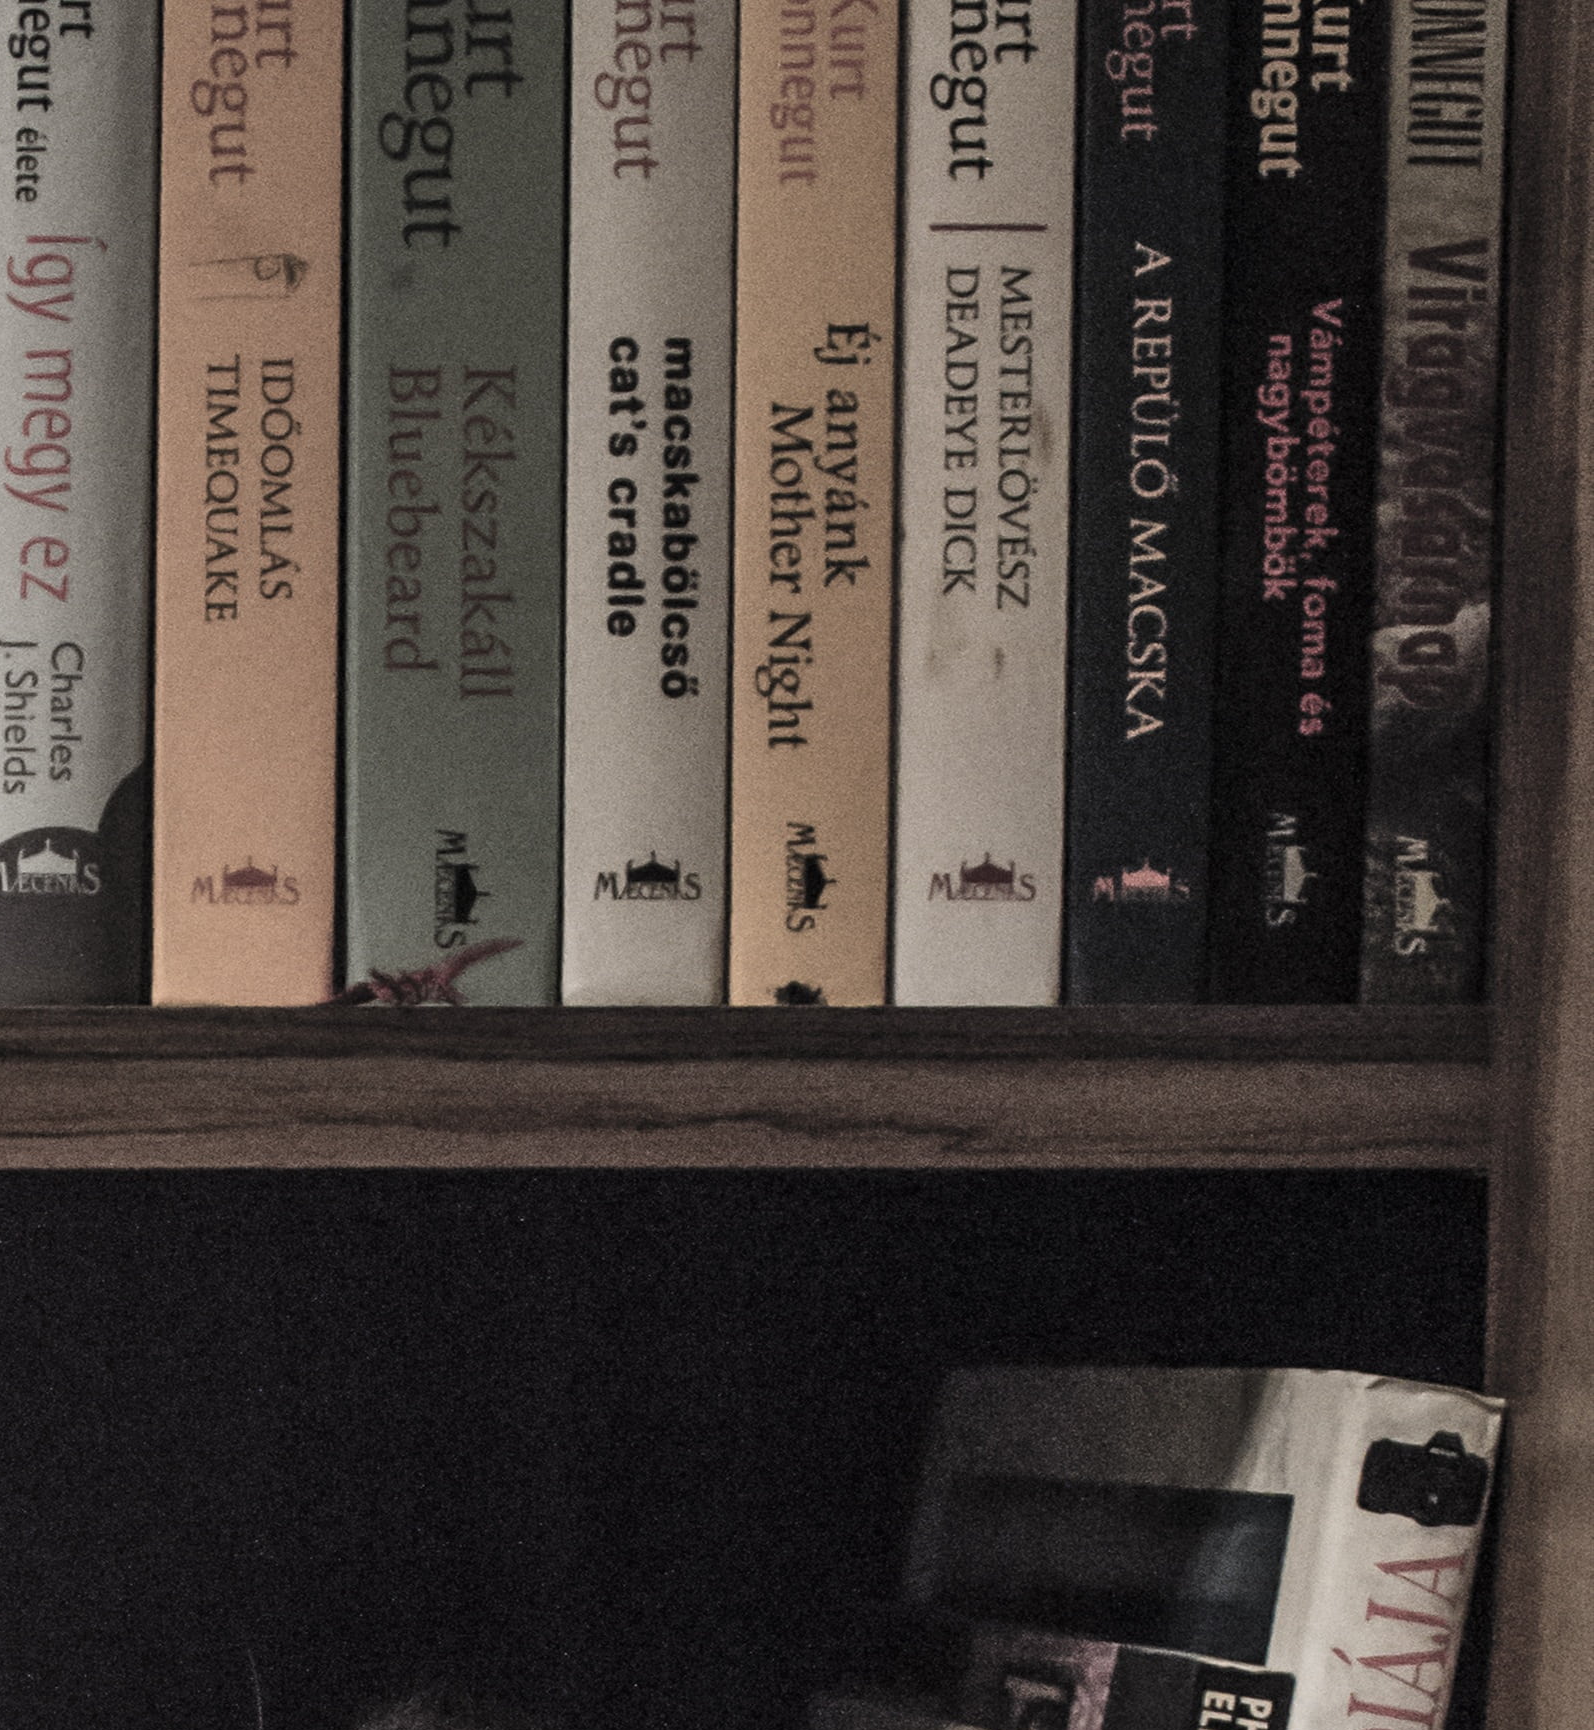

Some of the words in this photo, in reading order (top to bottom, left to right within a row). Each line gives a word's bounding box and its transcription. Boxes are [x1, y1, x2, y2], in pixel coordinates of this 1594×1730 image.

[14, 127, 46, 203] élete
[7, 234, 107, 323] Így
[1134, 240, 1173, 278] A
[608, 335, 647, 458] cat's
[812, 321, 882, 366] Éj
[943, 265, 981, 471] DEADEYE
[1128, 297, 1180, 500] REPÜLŐ
[4, 348, 73, 513] megy
[204, 353, 242, 623] TIMEQUAKE
[767, 402, 816, 594] Mother
[814, 388, 872, 587] anyánk
[996, 266, 1041, 610] MESTERLÖVÉSZ
[1256, 333, 1302, 601] nagybömbök
[19, 534, 71, 602] ez
[384, 364, 442, 674] Bluebeard
[608, 476, 646, 637] cradle
[660, 336, 700, 700] macskabölcső
[942, 485, 978, 596] DICK
[755, 610, 814, 751] Night
[1124, 517, 1168, 741] MACSKA
[1301, 576, 1340, 680] foma
[3, 670, 39, 795] Shields
[50, 641, 85, 783] Charles
[1299, 692, 1333, 738] és
